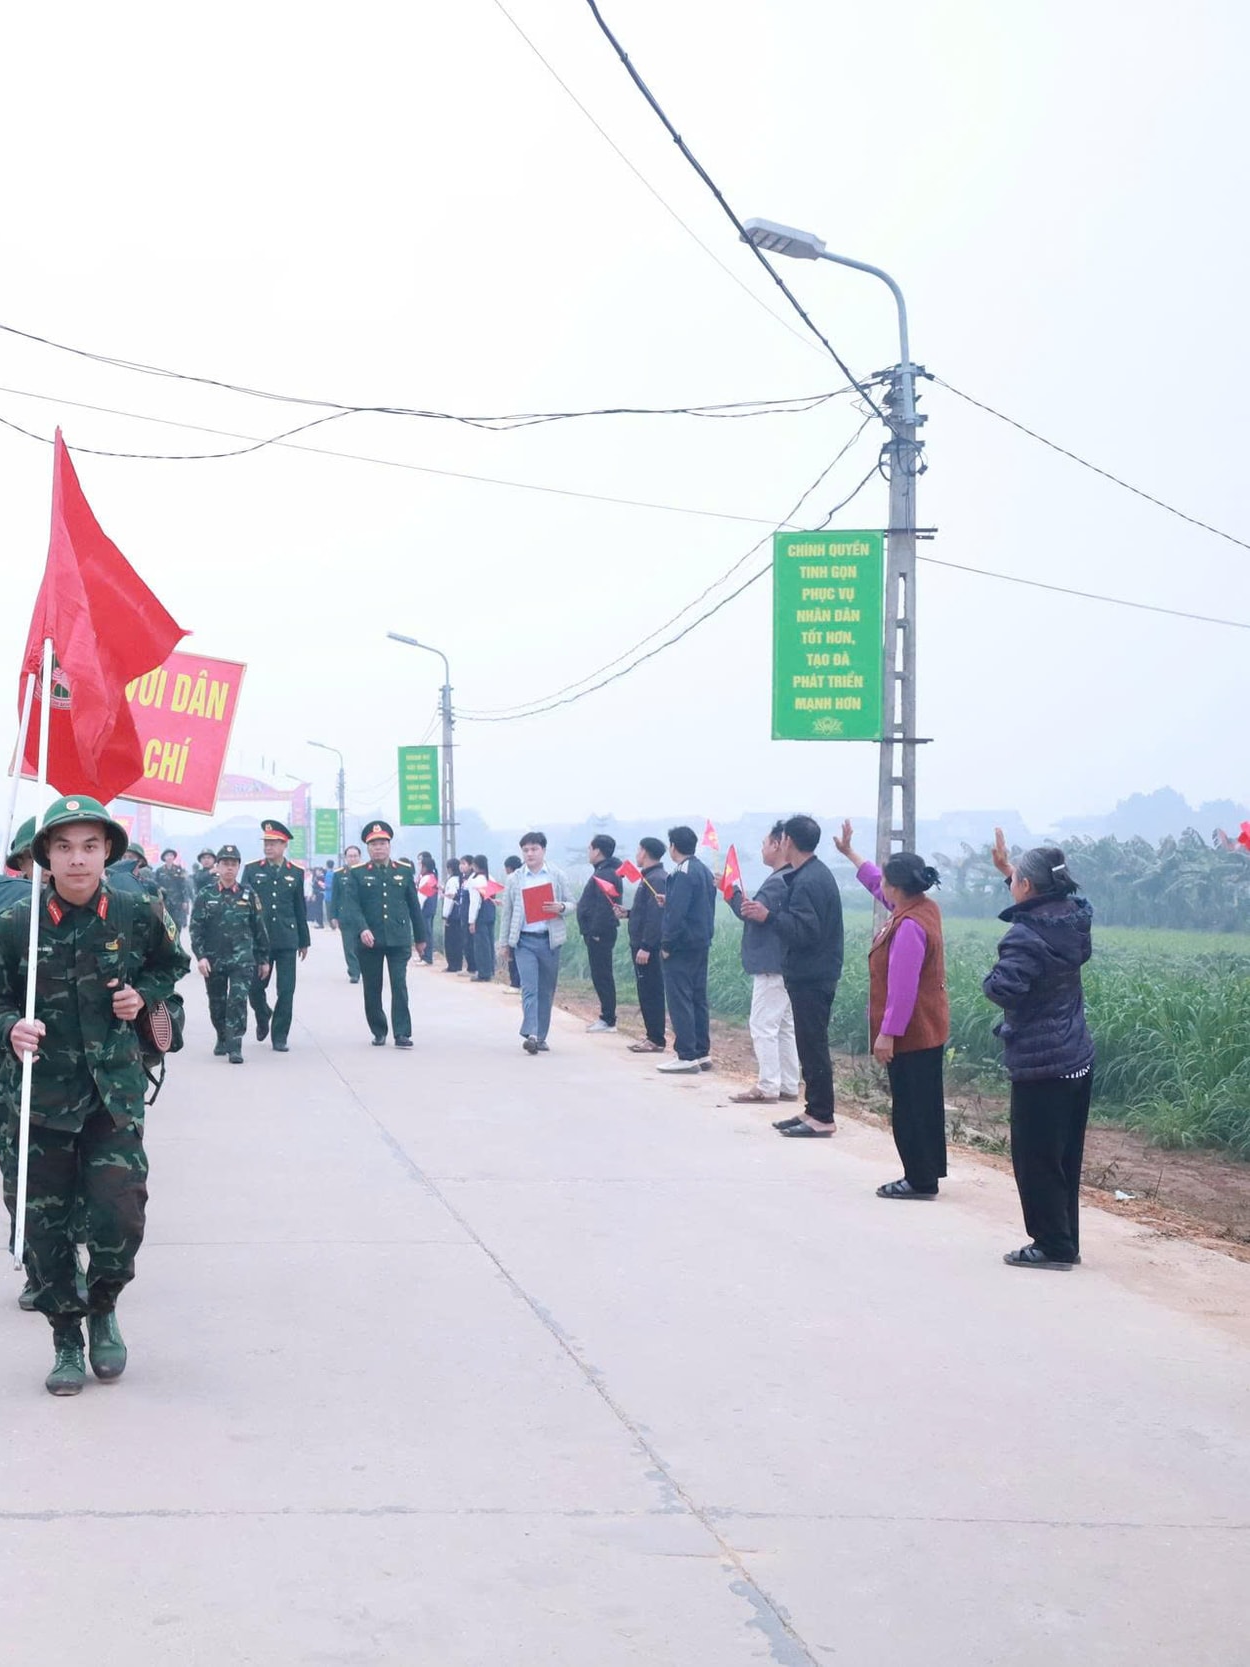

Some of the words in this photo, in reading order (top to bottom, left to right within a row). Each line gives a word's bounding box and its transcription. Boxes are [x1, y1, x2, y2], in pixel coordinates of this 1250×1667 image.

[788, 542, 825, 557] CHÍNH
[799, 565, 828, 579] TINH
[831, 565, 857, 581] GỌN
[802, 587, 835, 603] PHỤC
[838, 587, 855, 603] VỤ
[796, 607, 830, 623] NHÂN
[834, 607, 860, 622] DÂN
[801, 628, 822, 644] TỐT
[806, 653, 830, 669] TẠO
[793, 673, 824, 688] PHÁT
[827, 670, 864, 688] TRIỂN
[170, 669, 229, 722] DÂN
[795, 697, 832, 712] MẠNH
[835, 696, 861, 710] HƠN
[143, 737, 192, 785] CHÍ
